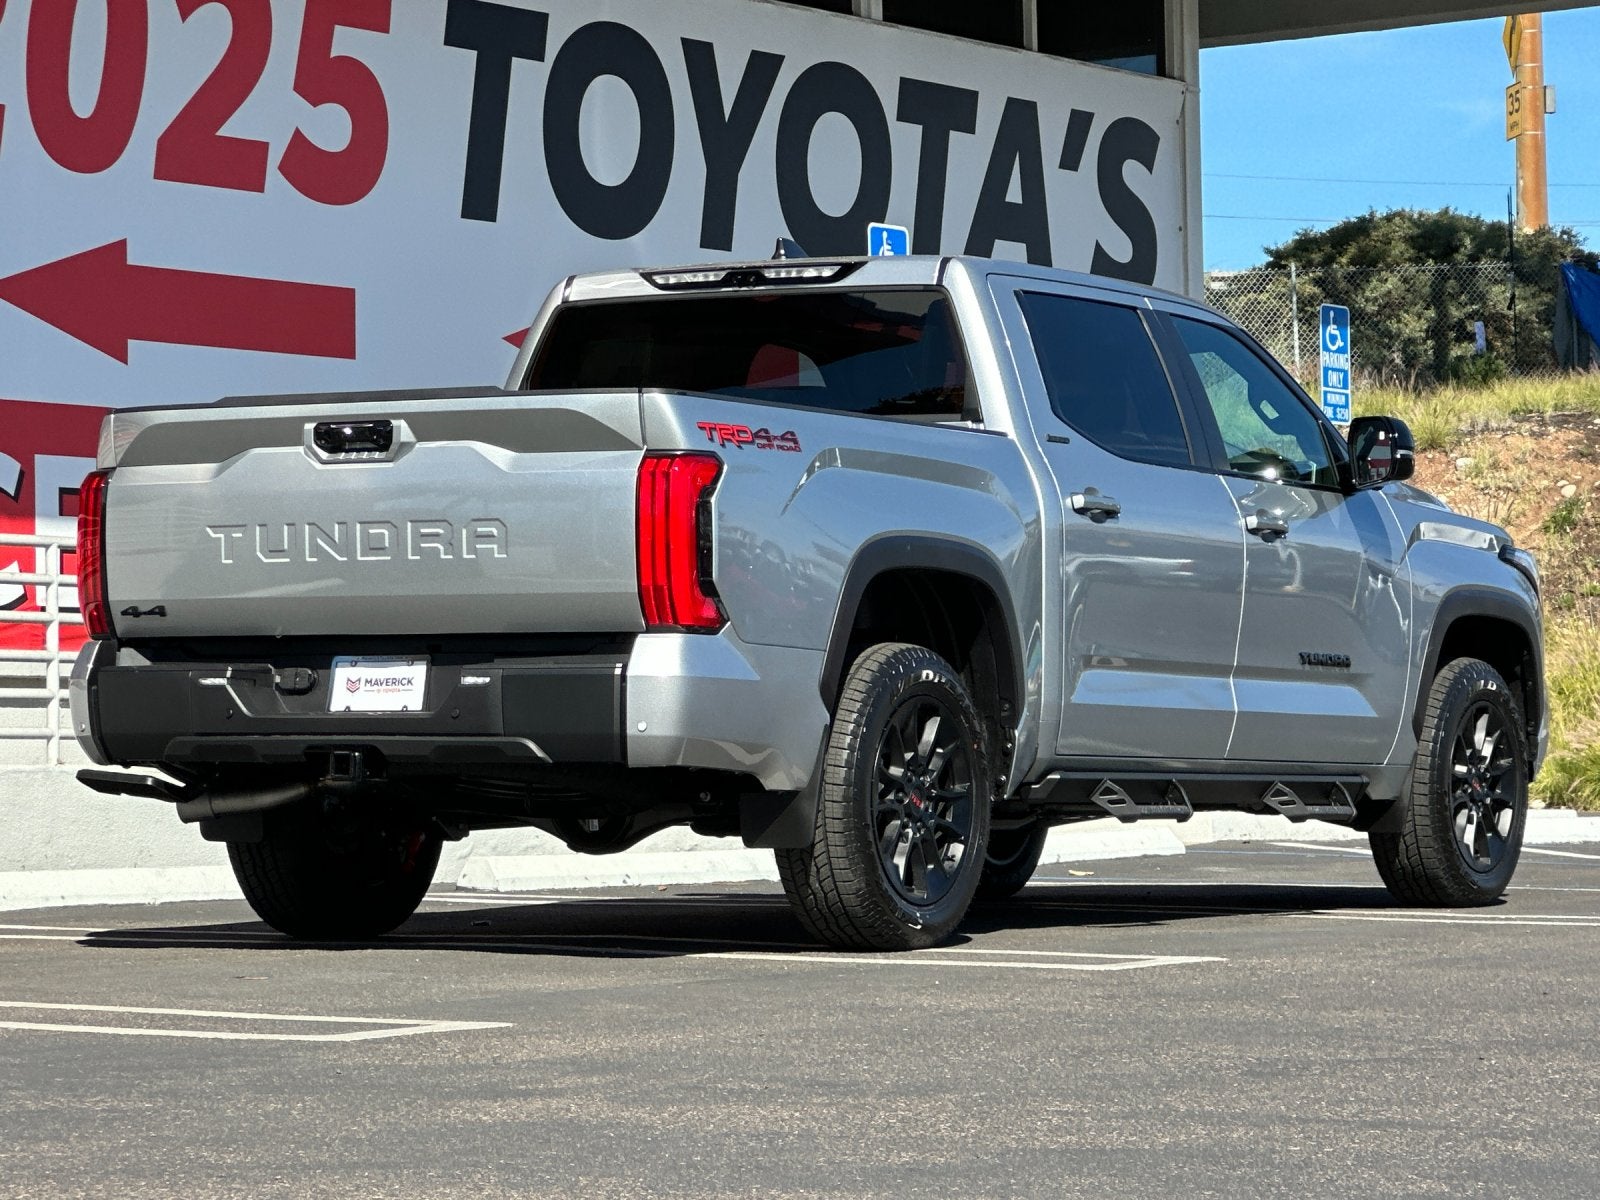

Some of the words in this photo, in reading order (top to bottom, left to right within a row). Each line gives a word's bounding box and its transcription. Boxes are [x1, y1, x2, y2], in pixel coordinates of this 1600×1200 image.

[1508, 89, 1521, 116] 35
[0, 0, 391, 206] 025
[443, 0, 1160, 287] TOYOTA'S
[1323, 352, 1348, 370] PARKING
[1328, 370, 1344, 387] ONLY
[697, 421, 753, 449] TRD
[756, 442, 775, 450] OFF
[776, 444, 802, 452] ROAD
[205, 517, 508, 564] TUNDRA
[364, 677, 414, 687] MAVERICK
